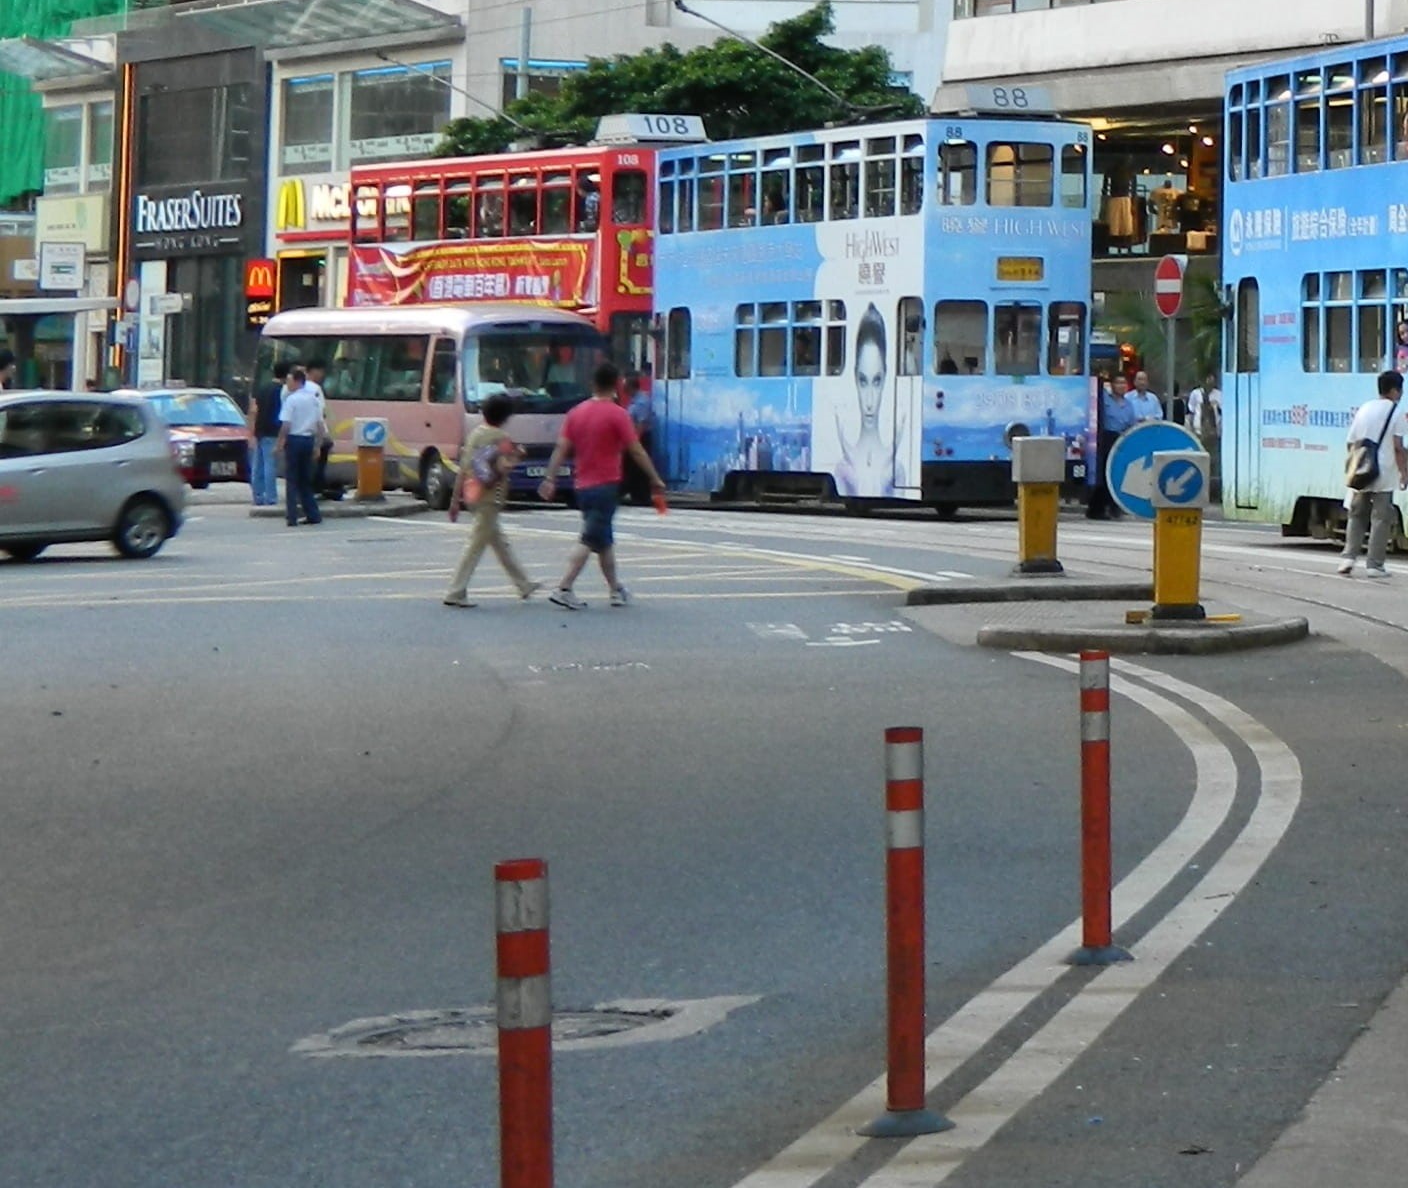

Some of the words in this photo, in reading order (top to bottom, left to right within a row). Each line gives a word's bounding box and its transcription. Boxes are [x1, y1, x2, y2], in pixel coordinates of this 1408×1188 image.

[993, 87, 1029, 108] 88
[643, 116, 689, 135] 108
[945, 127, 963, 138] 88
[1076, 131, 1089, 143] 88
[617, 154, 639, 165] 108
